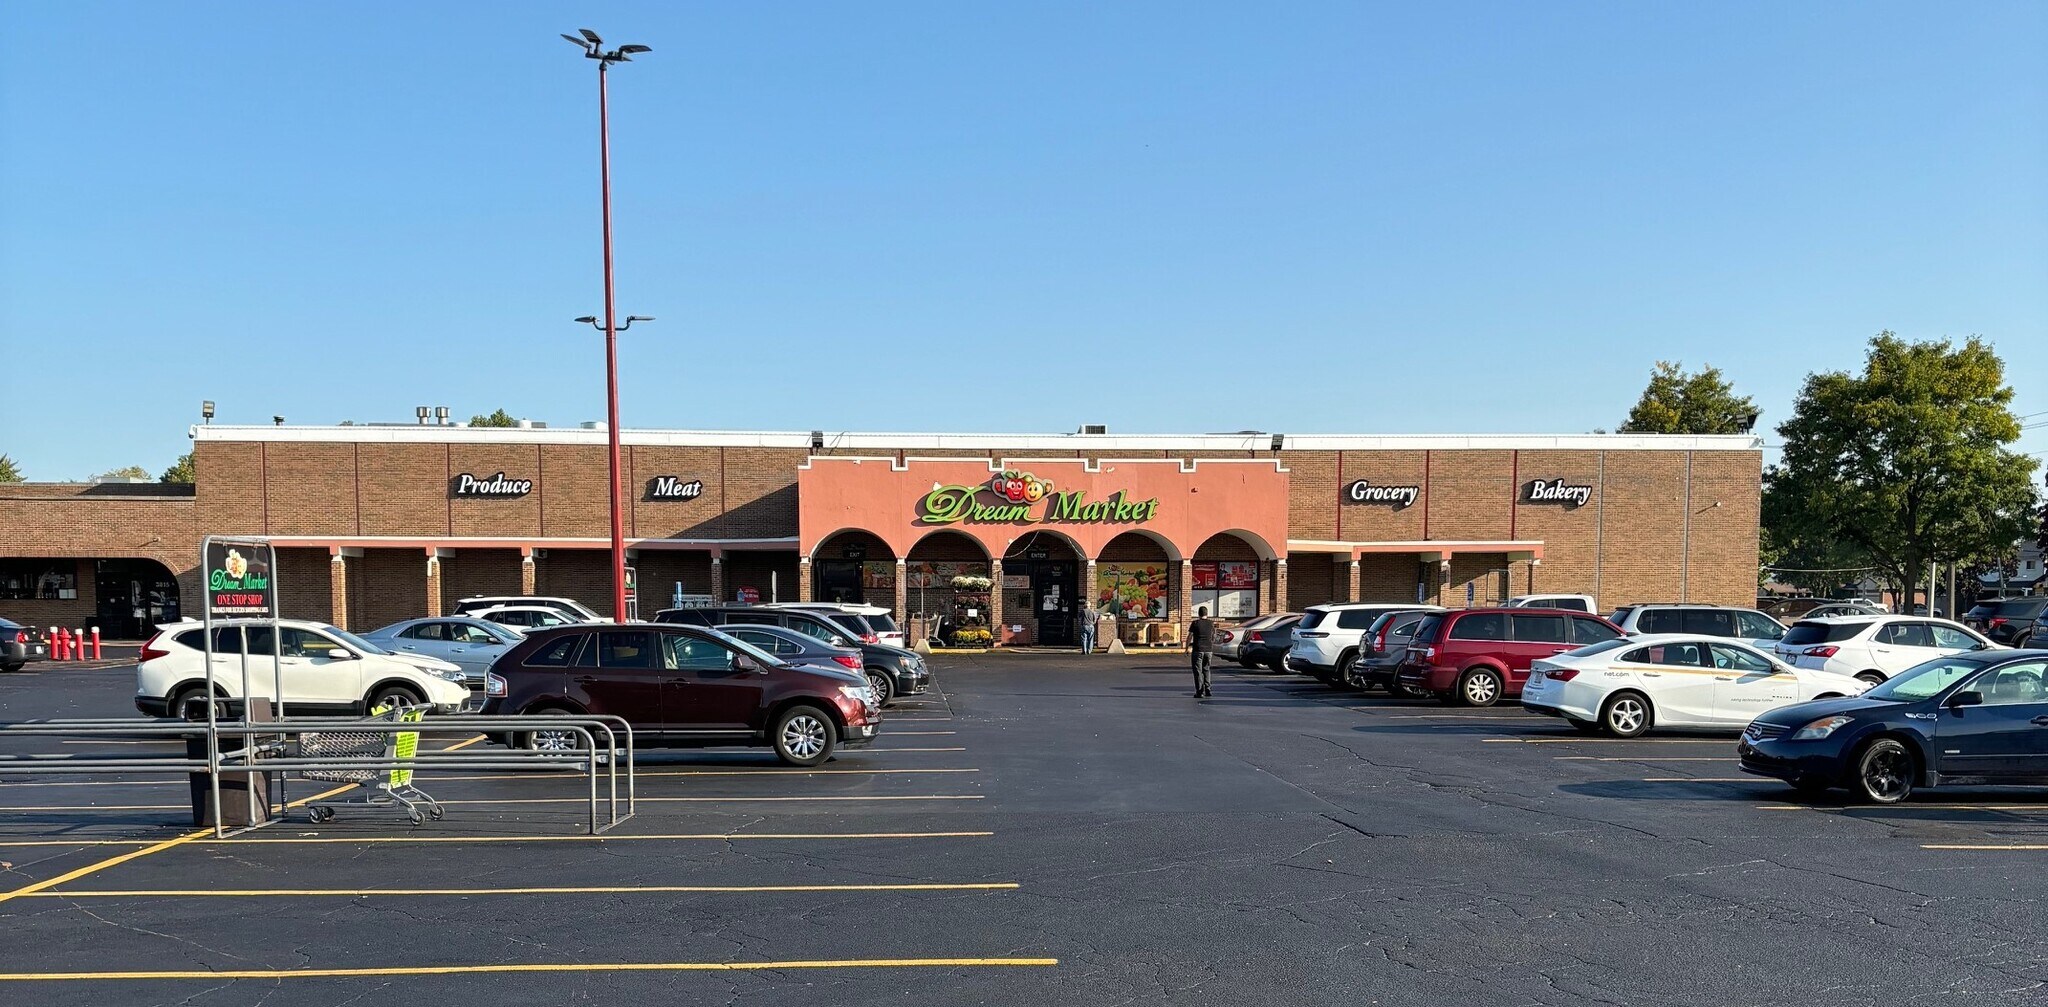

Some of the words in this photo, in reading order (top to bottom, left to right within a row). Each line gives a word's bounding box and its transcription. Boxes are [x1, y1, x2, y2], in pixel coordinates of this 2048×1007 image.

[457, 473, 531, 494] Produce
[653, 477, 702, 497] Meat
[1350, 480, 1419, 505] Grocery
[1530, 480, 1592, 506] Bakery
[921, 484, 1043, 523] Dream
[1050, 489, 1159, 521] Market
[210, 569, 242, 590] Dream
[243, 572, 268, 590] Market
[217, 594, 231, 605] ONE
[231, 594, 247, 605] STOP
[247, 594, 263, 605] SHOP
